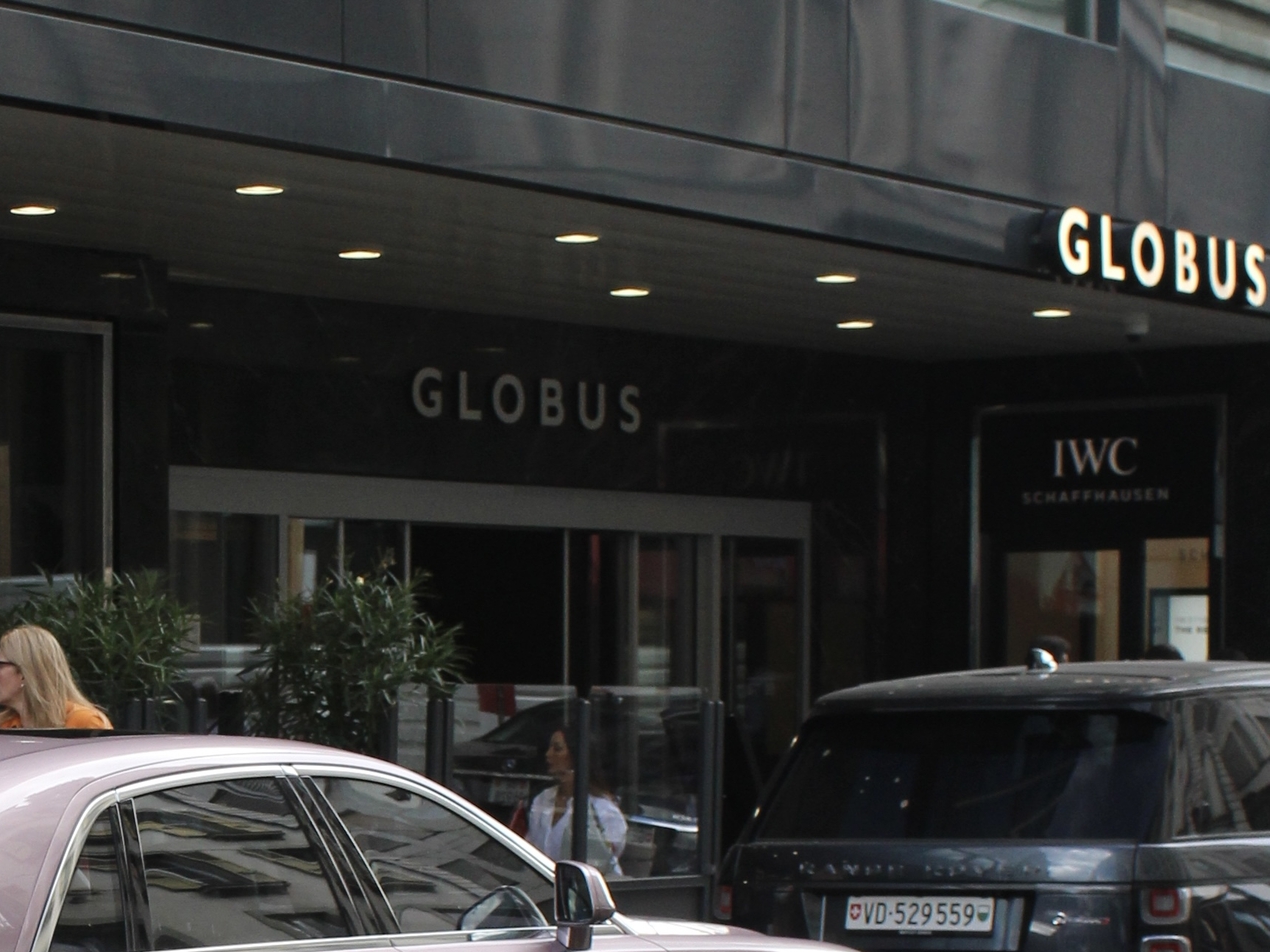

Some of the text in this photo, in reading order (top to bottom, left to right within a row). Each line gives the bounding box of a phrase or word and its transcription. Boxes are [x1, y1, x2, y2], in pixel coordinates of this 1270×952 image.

[1058, 206, 1267, 307] GLOBUS
[412, 367, 641, 433] GLOBUS
[1053, 436, 1138, 477] IWC
[1021, 487, 1170, 505] SCHAFFHAUSEN
